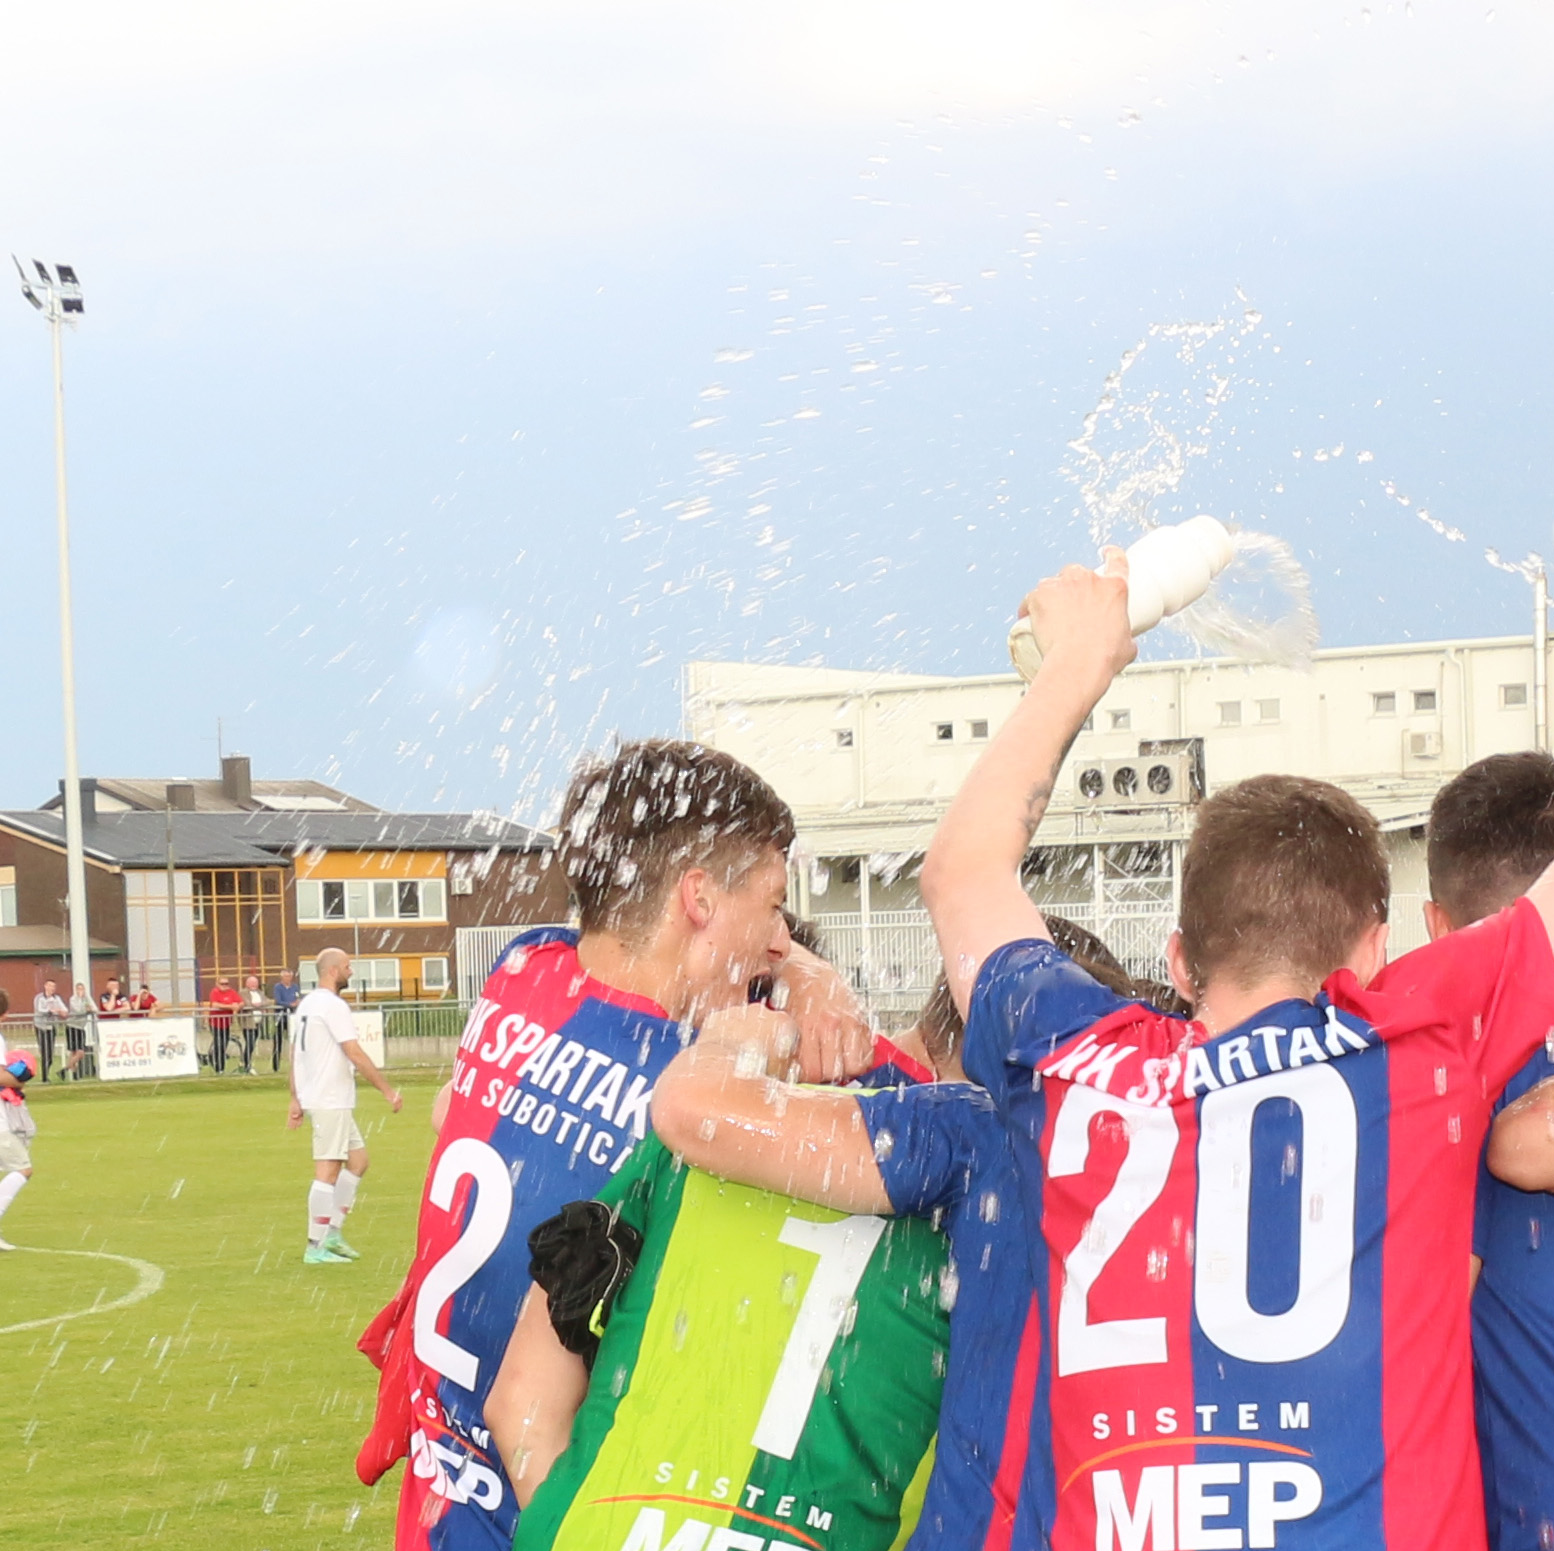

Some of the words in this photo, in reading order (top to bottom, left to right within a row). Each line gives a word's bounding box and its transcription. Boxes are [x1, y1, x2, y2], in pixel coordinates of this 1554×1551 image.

[106, 1039, 151, 1058] ZAGI
[480, 1013, 654, 1140] SPARTAK
[412, 1137, 513, 1391] 2
[1048, 1063, 1358, 1377] 20
[751, 1214, 887, 1460] 1
[1092, 1402, 1310, 1439] SISTEM
[654, 1462, 833, 1531] SISTEM
